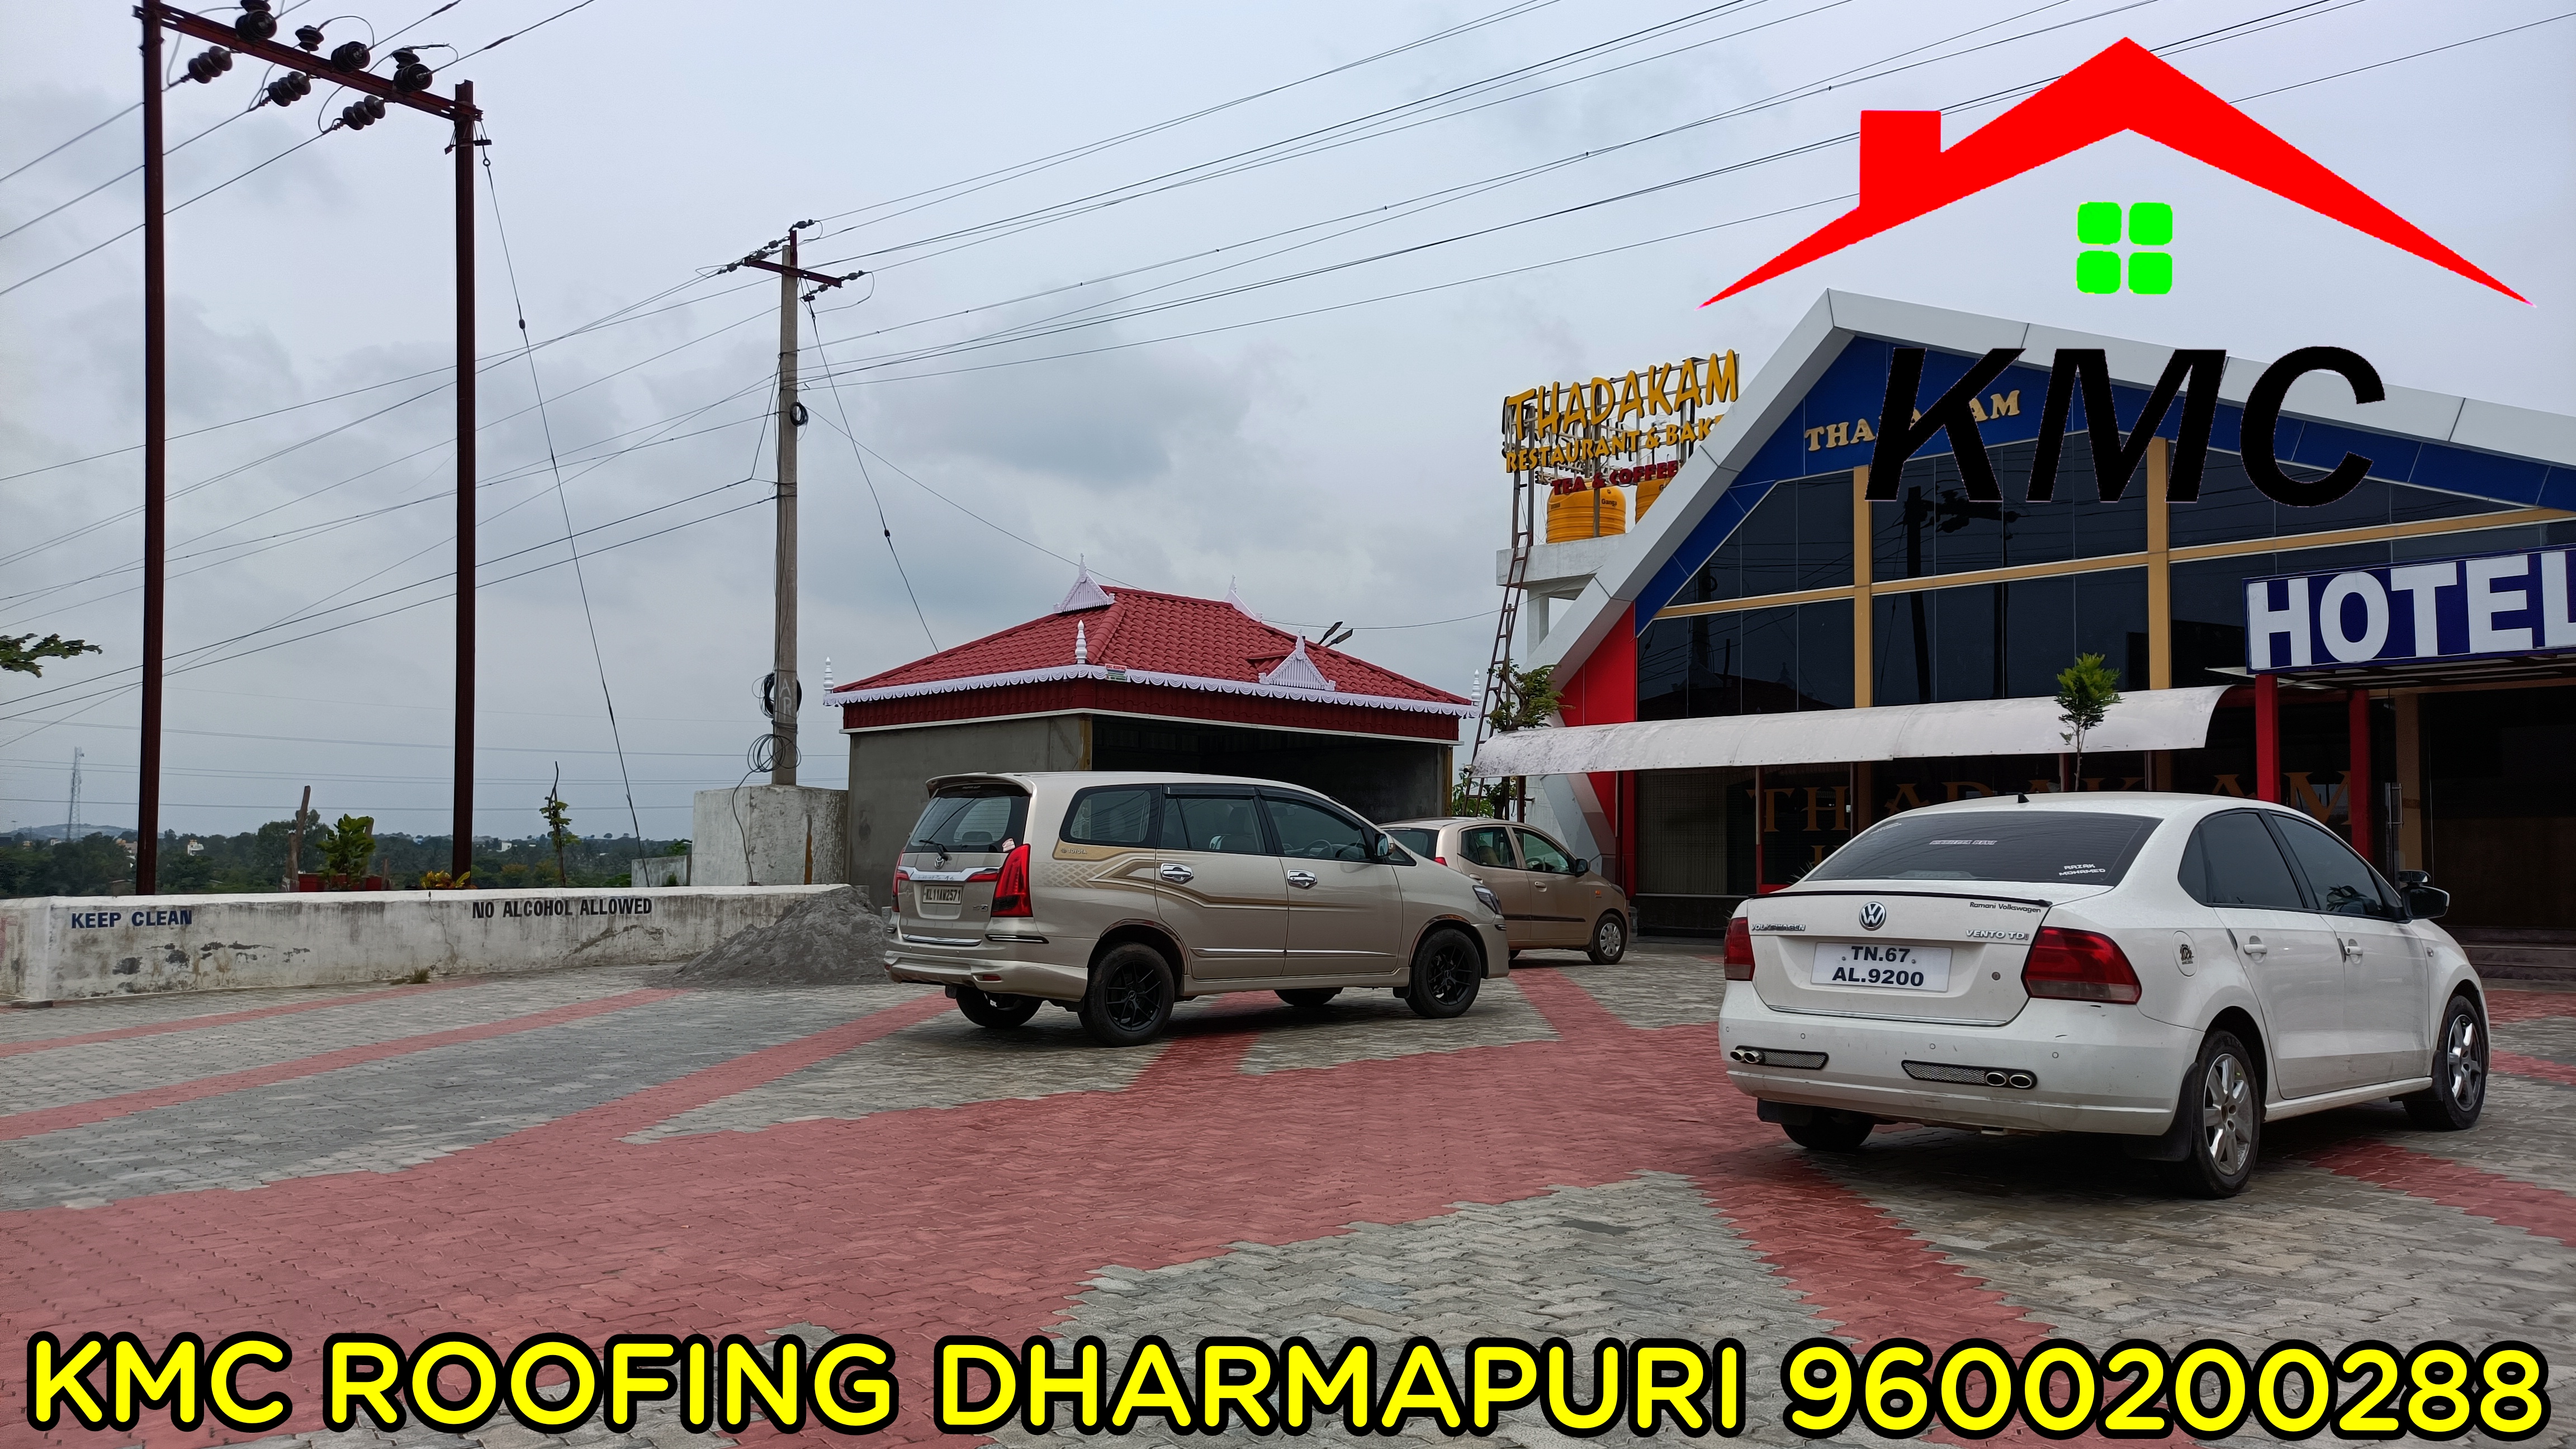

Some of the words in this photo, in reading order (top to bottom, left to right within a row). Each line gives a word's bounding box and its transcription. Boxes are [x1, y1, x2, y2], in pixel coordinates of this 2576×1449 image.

[1505, 349, 1739, 441] THADAKAM
[1506, 430, 1642, 473] RESTAURANT
[1645, 427, 1661, 449] &
[1552, 476, 1588, 495] TEA
[1592, 472, 1607, 489] &
[1609, 460, 1679, 485] COFFEE
[1601, 498, 1618, 508] Ganga
[2248, 550, 2576, 669] HOTEL
[473, 901, 495, 918] NO
[503, 899, 572, 917] ALCOHOL
[580, 898, 652, 915] ALLOWED
[1969, 902, 1997, 910] Ramani
[1998, 903, 2042, 913] Volkswagen
[72, 912, 121, 929] KEEP
[131, 911, 192, 926] CLEAN
[1966, 930, 2006, 939] VENTO
[1851, 946, 1911, 962] TN.67
[1832, 967, 1924, 987] AL.9200
